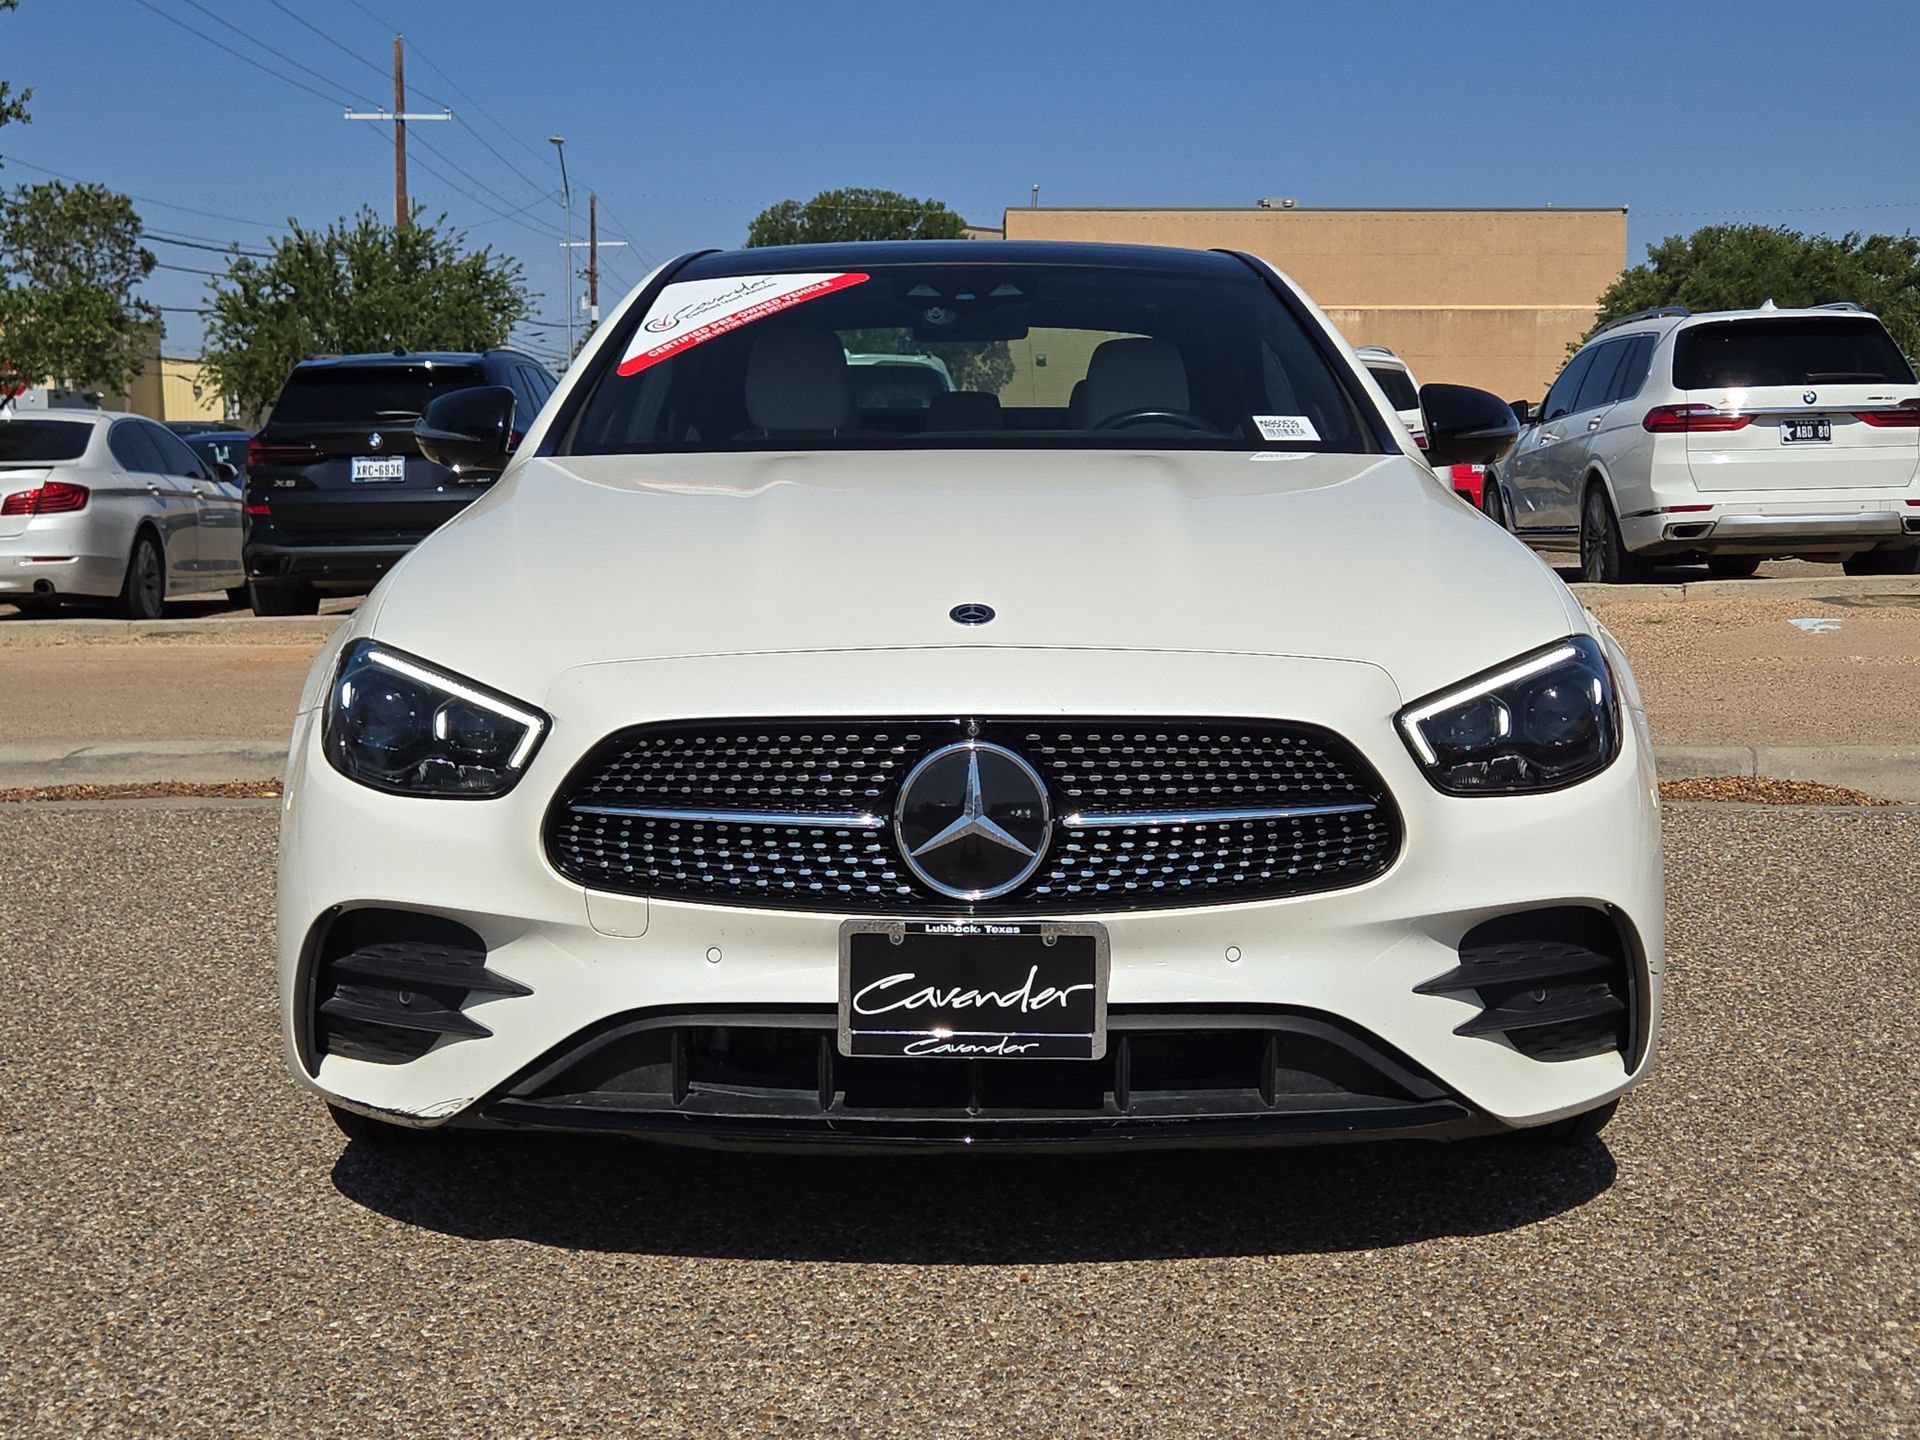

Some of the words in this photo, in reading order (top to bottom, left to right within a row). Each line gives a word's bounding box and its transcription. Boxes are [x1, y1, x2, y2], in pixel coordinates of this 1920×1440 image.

[648, 325, 710, 358] CERTIFIED
[711, 298, 782, 331] PRE-OWNED
[784, 281, 834, 302] VEHICLE
[1796, 425, 1813, 438] ABD
[1818, 425, 1829, 438] 80
[985, 925, 1020, 934] Texas
[853, 965, 1095, 1015] Cavender
[903, 1036, 1040, 1056] Cavender
